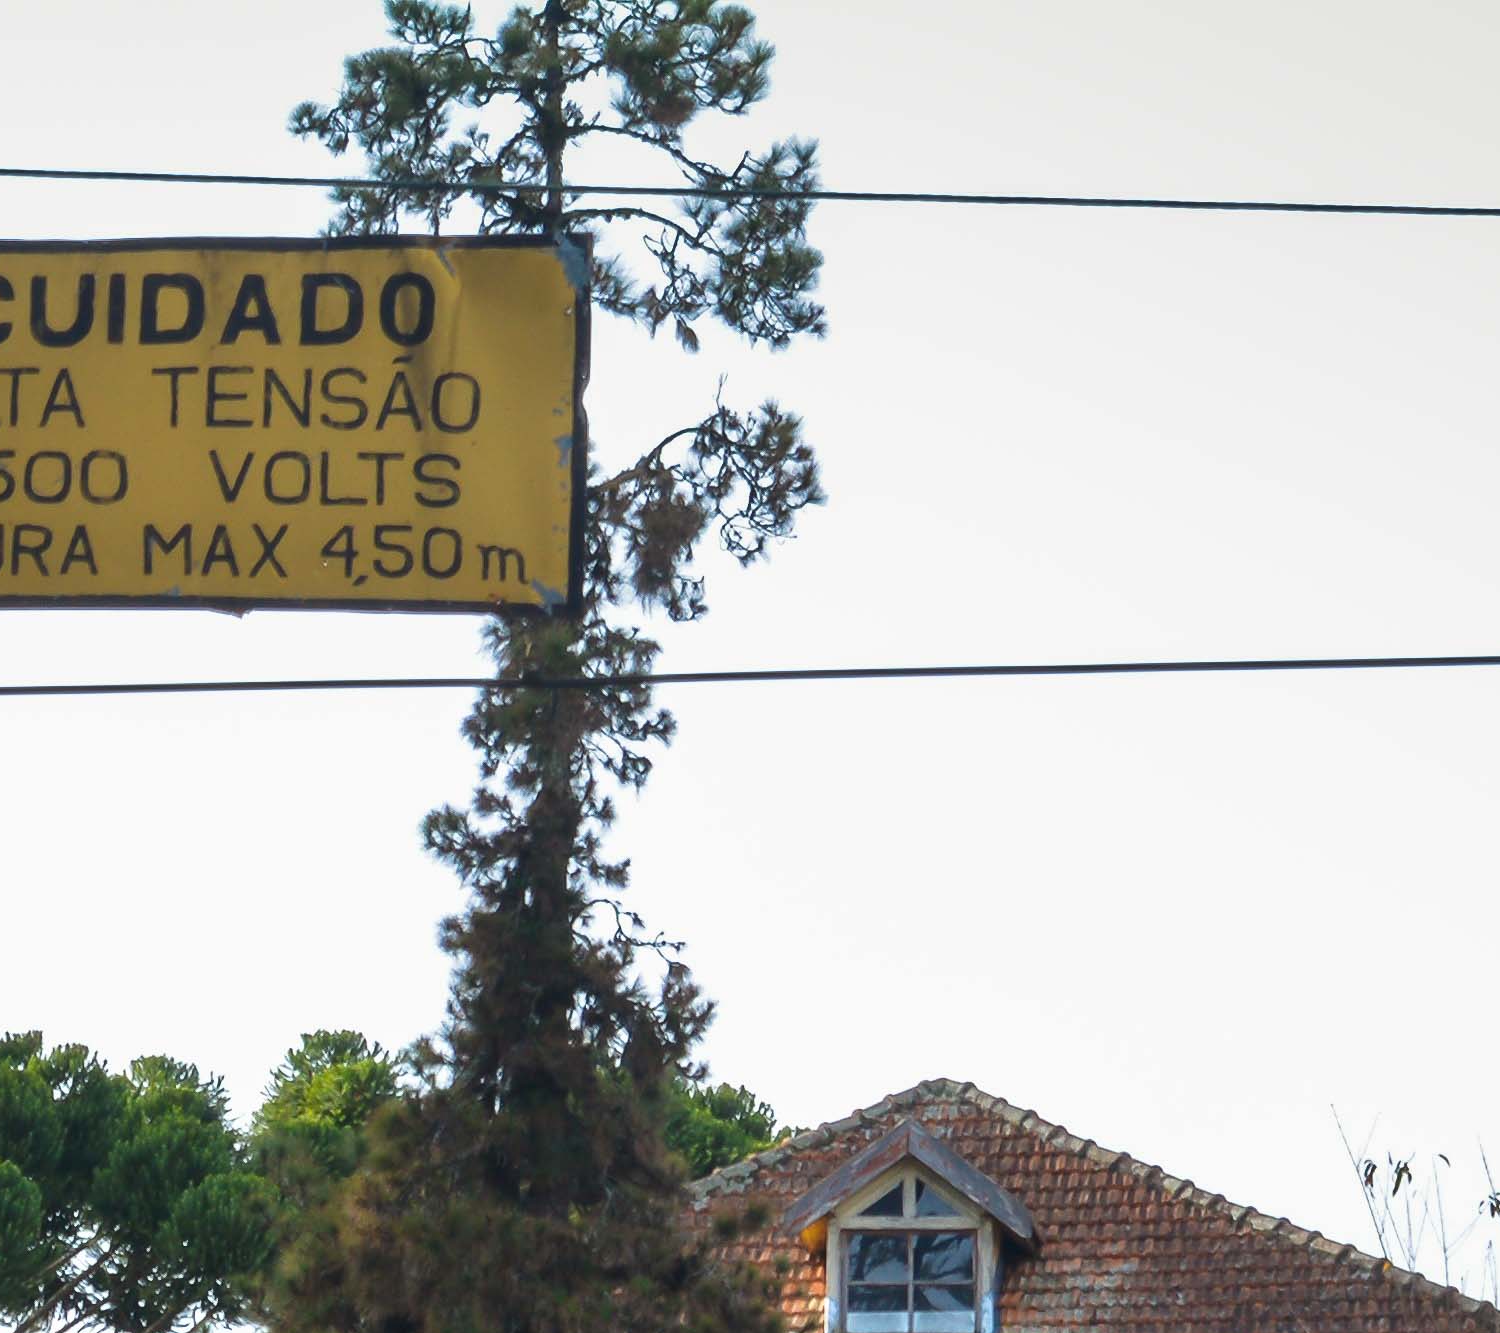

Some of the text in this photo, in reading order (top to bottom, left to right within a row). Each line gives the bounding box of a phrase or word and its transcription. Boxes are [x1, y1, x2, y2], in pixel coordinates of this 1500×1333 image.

[151, 356, 482, 435] TENSÃO
[210, 450, 463, 509] VOLTS
[143, 523, 290, 579] MAX
